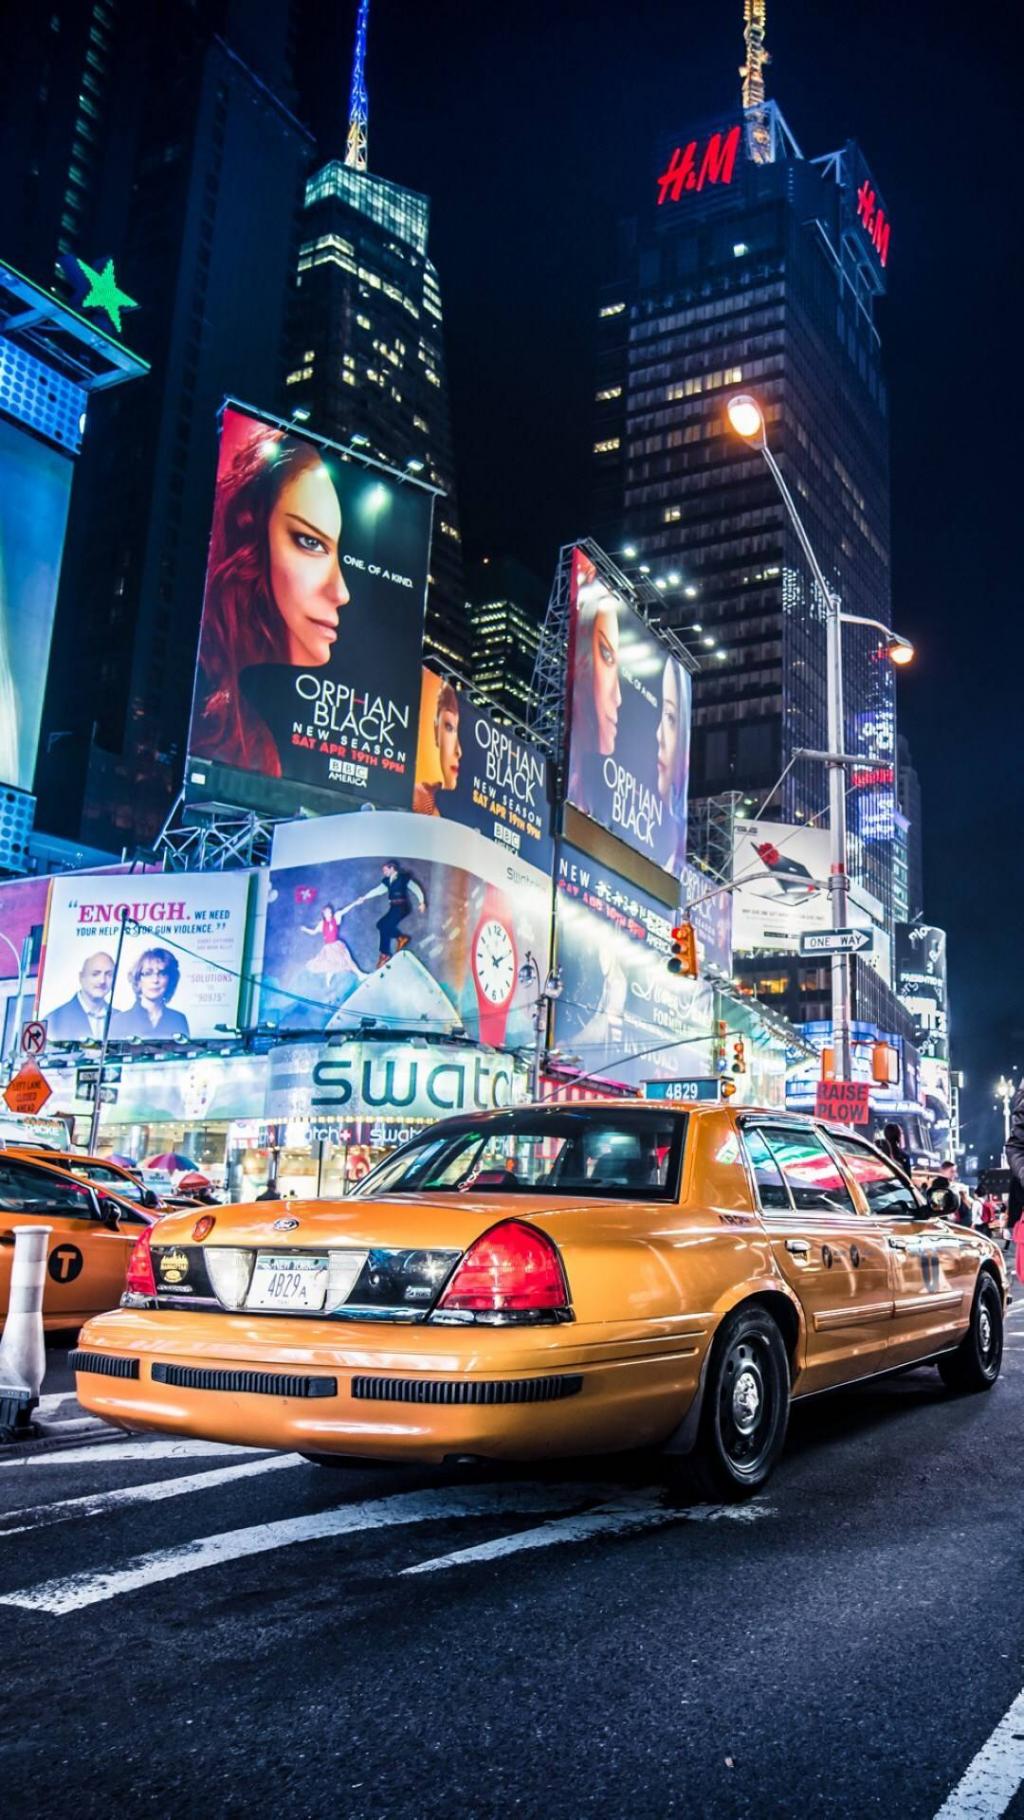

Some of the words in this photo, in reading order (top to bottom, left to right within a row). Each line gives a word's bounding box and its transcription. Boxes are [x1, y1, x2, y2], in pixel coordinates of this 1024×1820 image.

[656, 125, 741, 205] H&M
[857, 180, 890, 267] H&M
[368, 564, 381, 575] OF
[382, 570, 390, 579] A
[295, 674, 409, 728] ORPHAN
[292, 722, 329, 741] NEW
[341, 735, 406, 762] SEASON
[314, 700, 396, 746] BLACK
[291, 733, 316, 749] SAT
[320, 742, 346, 758] APR
[351, 750, 378, 766] 19TH
[381, 758, 405, 774] 9PM
[329, 758, 369, 779] BBC
[475, 719, 544, 787] ORPHAN
[328, 772, 367, 788] AMERICA
[486, 751, 536, 807] BLACK
[603, 757, 663, 826] ORPHAN
[472, 790, 488, 808] SAT
[489, 800, 507, 820] APR
[526, 821, 542, 840] 9PM
[473, 776, 496, 799] NEW
[502, 795, 542, 827] SEASON
[612, 791, 655, 848] BLACK
[494, 822, 521, 849] BBC
[559, 858, 590, 888] NEW
[76, 926, 96, 937] YOUR
[99, 925, 119, 936] HELP
[155, 924, 172, 934] GUN
[194, 911, 208, 920] WE
[209, 909, 230, 920] NEED
[809, 937, 830, 947] ONE
[840, 934, 863, 946] WAY
[817, 1084, 867, 1102] RAISE
[817, 1103, 864, 1120] PLOW
[57, 1251, 77, 1279] T
